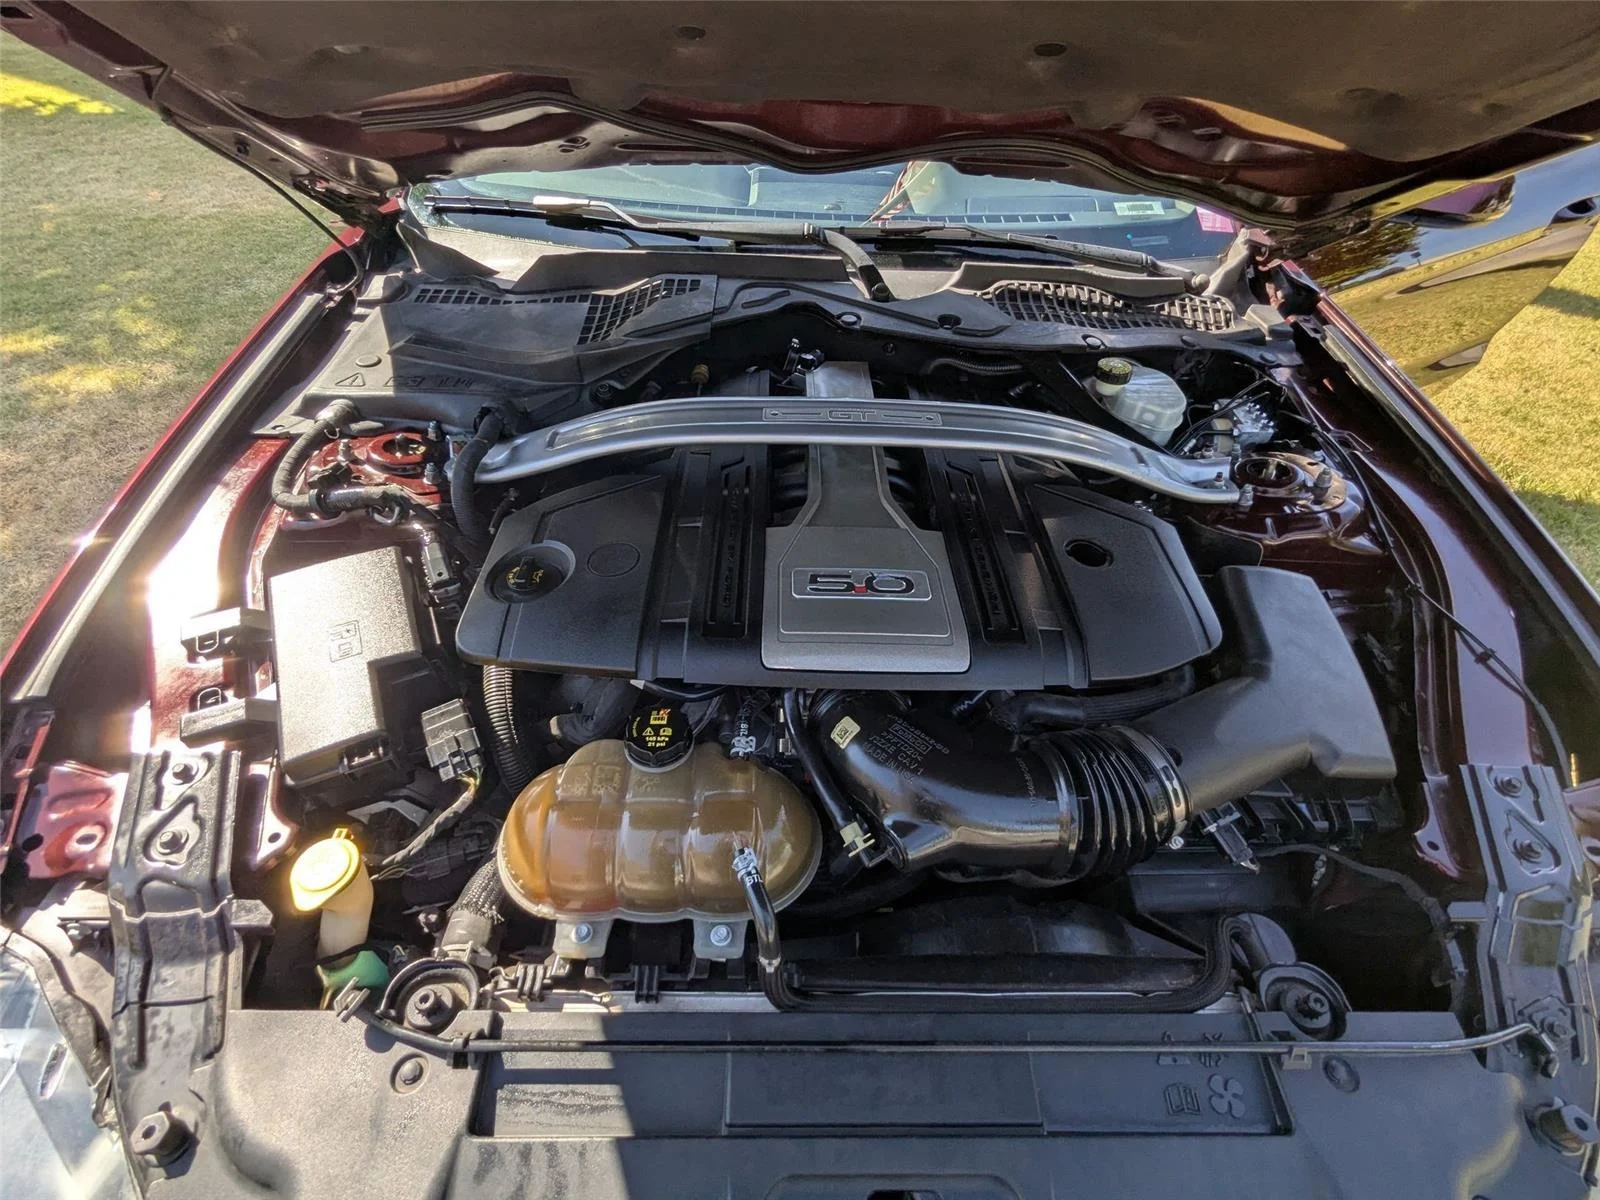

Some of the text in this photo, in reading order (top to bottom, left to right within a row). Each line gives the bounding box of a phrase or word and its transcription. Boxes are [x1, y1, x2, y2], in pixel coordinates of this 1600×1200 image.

[826, 409, 877, 422] GT
[807, 573, 915, 594] 5.0
[886, 759, 898, 769] IN
